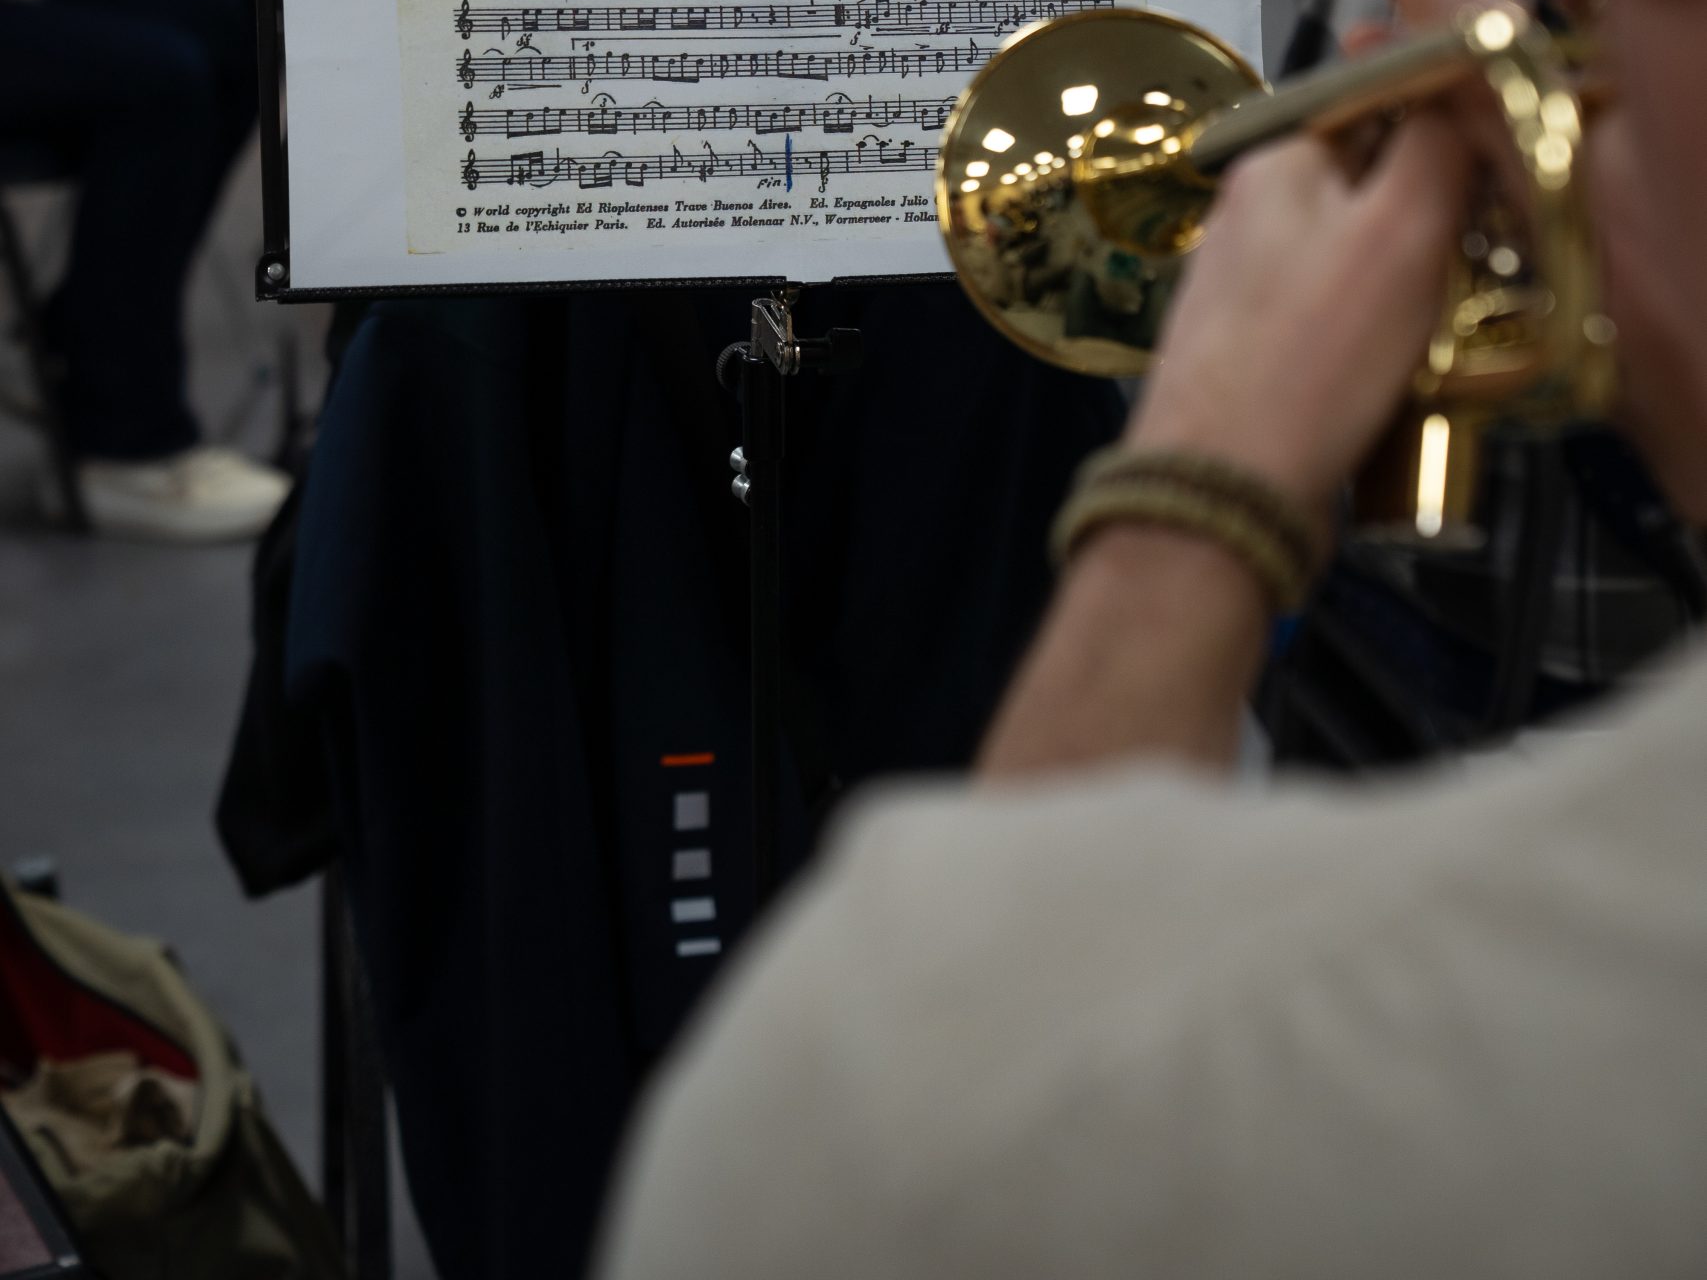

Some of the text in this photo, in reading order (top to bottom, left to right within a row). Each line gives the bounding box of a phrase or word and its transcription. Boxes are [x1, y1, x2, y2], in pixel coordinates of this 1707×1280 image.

[473, 204, 510, 217] World
[515, 203, 571, 219] copyright
[575, 202, 593, 214] Ed
[598, 200, 669, 215] Rioplatenses
[674, 200, 707, 212] Trave
[713, 199, 753, 212] Buenos
[758, 198, 792, 210] Aires.
[809, 197, 829, 209] Ed.
[833, 196, 896, 211] Espagnoles
[900, 195, 929, 207] Julio
[457, 222, 470, 233] 13
[476, 221, 500, 233] Rue
[505, 221, 520, 232] de
[594, 218, 628, 230] Paris.
[646, 217, 666, 229] Ed.
[671, 216, 725, 229] Autorisée
[731, 215, 785, 228] Molenaar
[825, 213, 891, 226] Wormerveer
